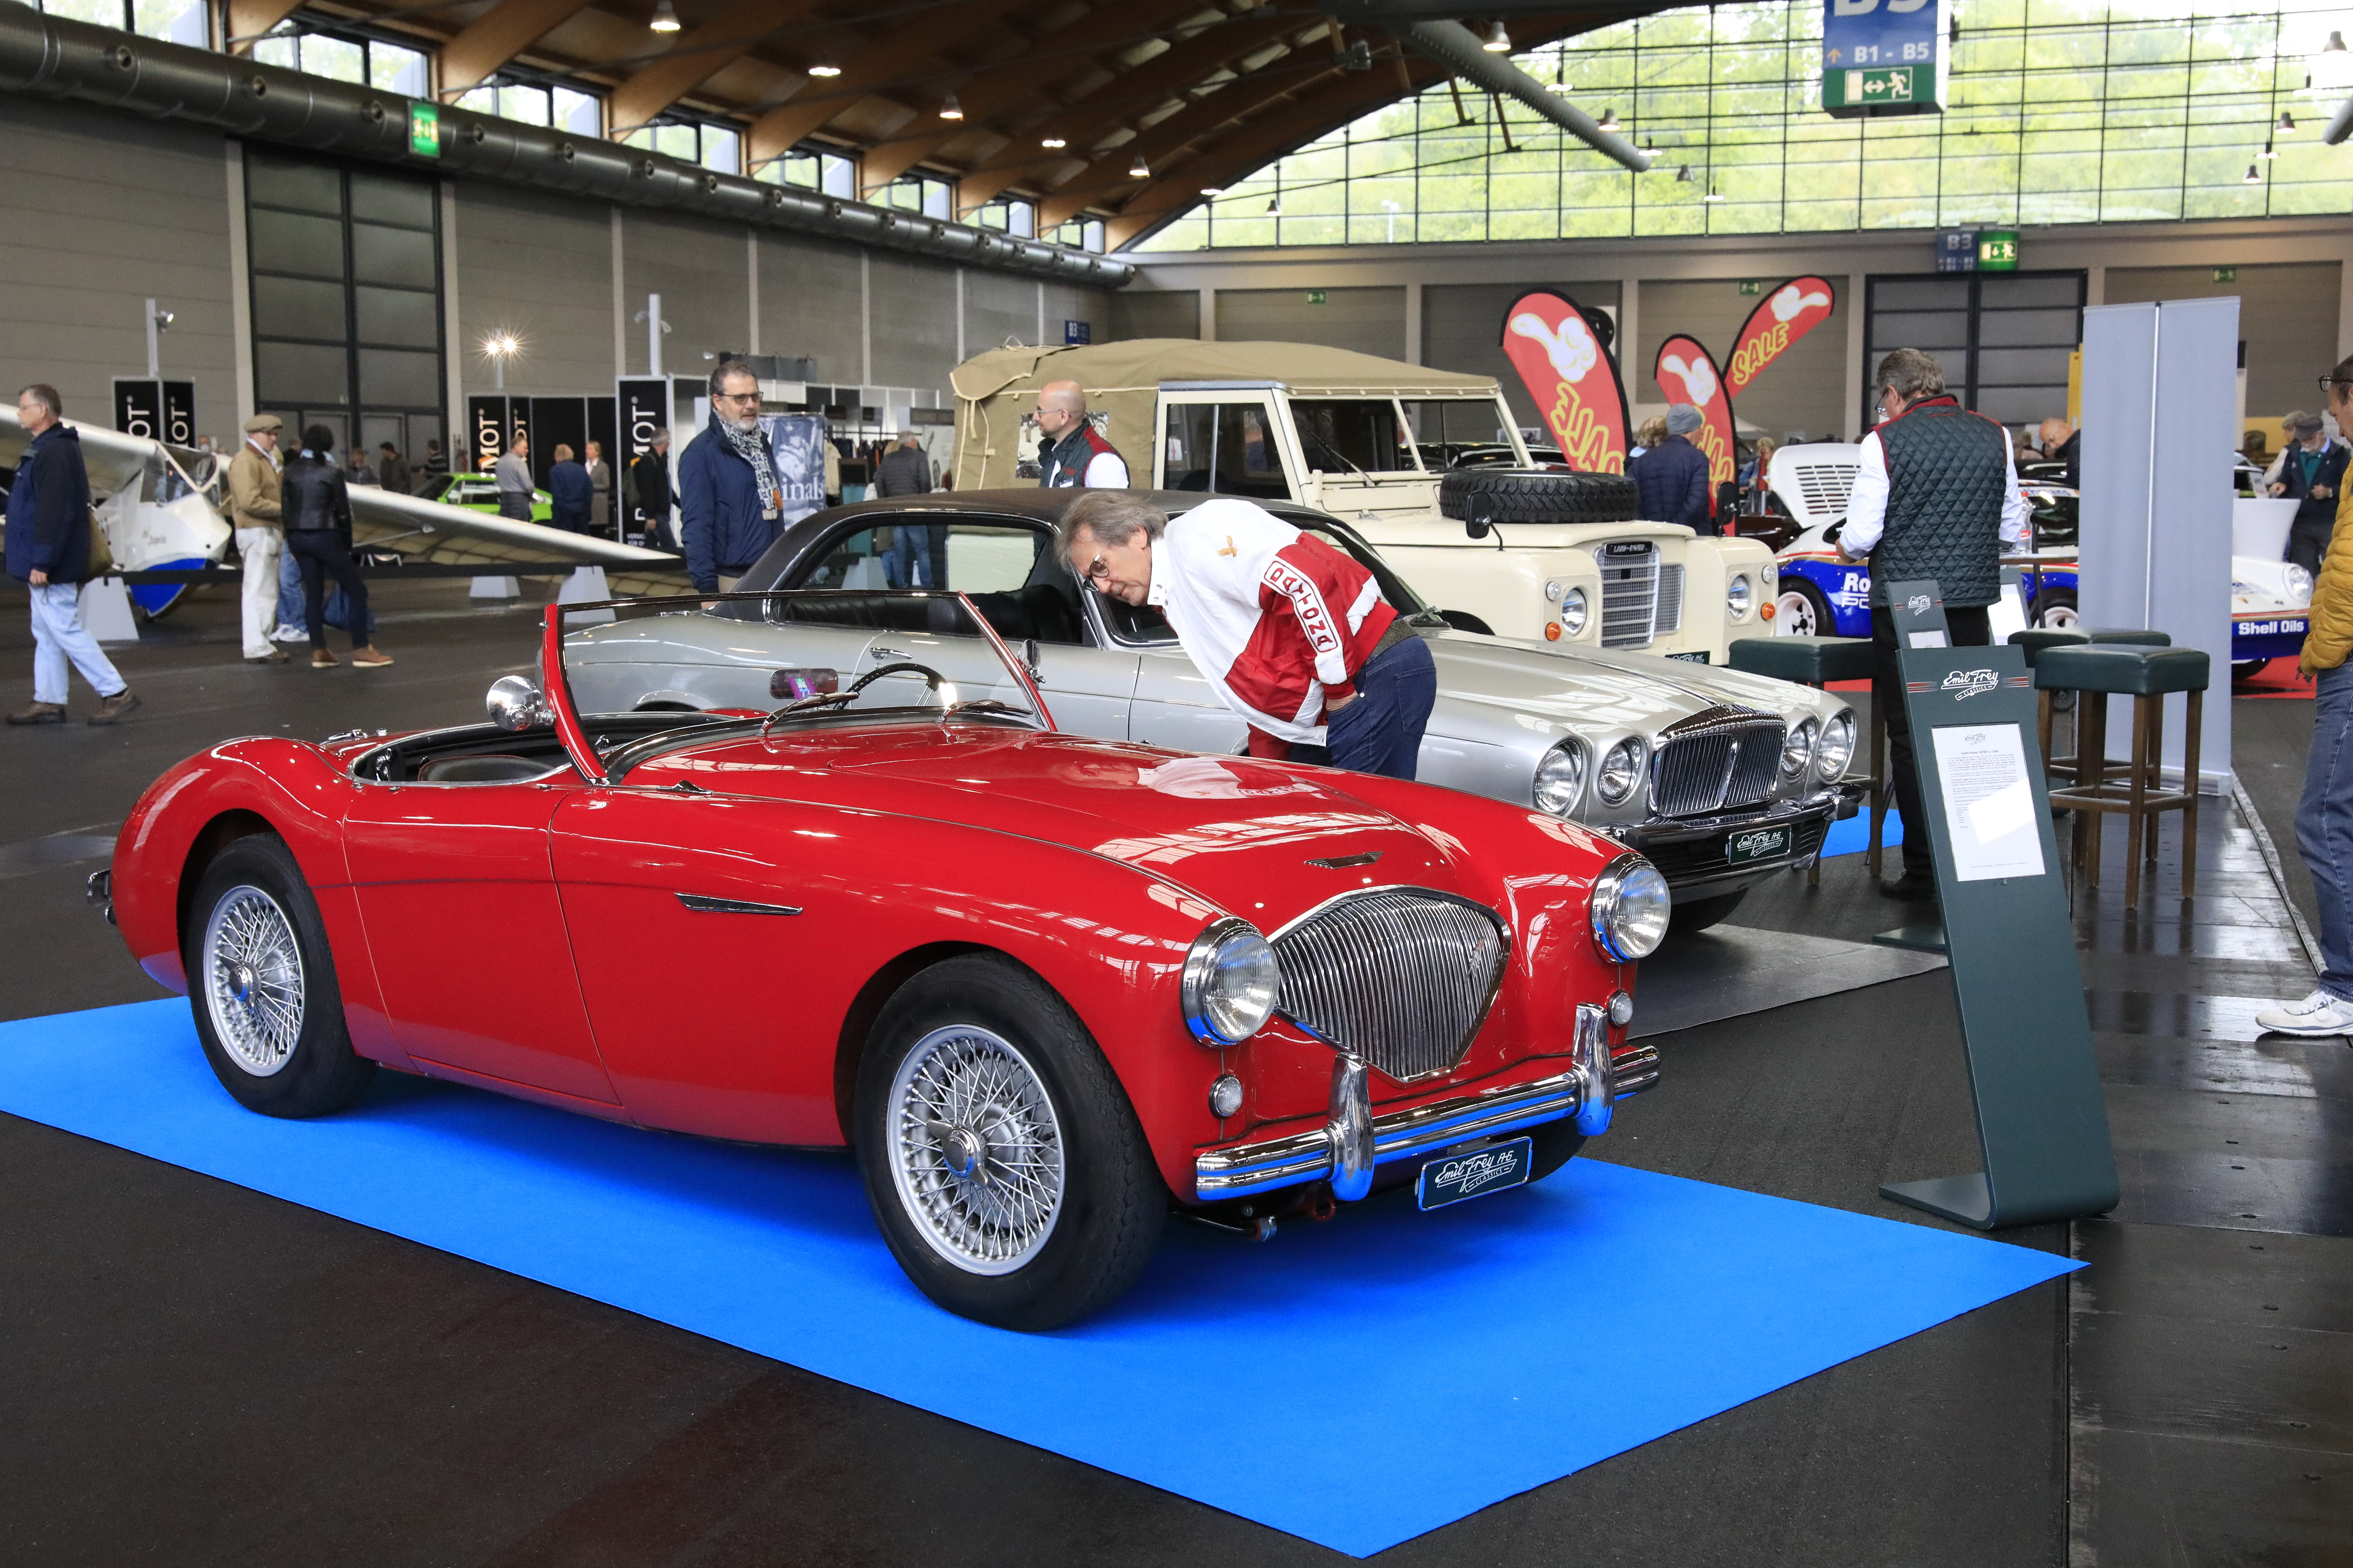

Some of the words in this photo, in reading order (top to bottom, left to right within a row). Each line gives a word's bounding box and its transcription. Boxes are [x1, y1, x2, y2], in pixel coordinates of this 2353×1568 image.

[1854, 45, 1878, 63] B1
[1903, 42, 1930, 60] B5
[1732, 322, 1790, 385] SALE
[479, 415, 500, 471] MOT
[782, 476, 824, 501] inals
[1270, 568, 1333, 646] DAYTONA
[2238, 621, 2278, 635] Shell
[2281, 620, 2304, 633] Oils
[1943, 671, 1971, 685] Emil
[1970, 669, 1998, 688] Frey
[1964, 685, 1987, 696] CLASSICS
[1737, 835, 1754, 848] Emil
[1771, 832, 1782, 840] AG
[1759, 843, 1775, 852] CLASSICS
[1435, 1162, 1464, 1183] Emil
[1497, 1150, 1514, 1164] AG
[1475, 1168, 1503, 1185] CLASSICS
